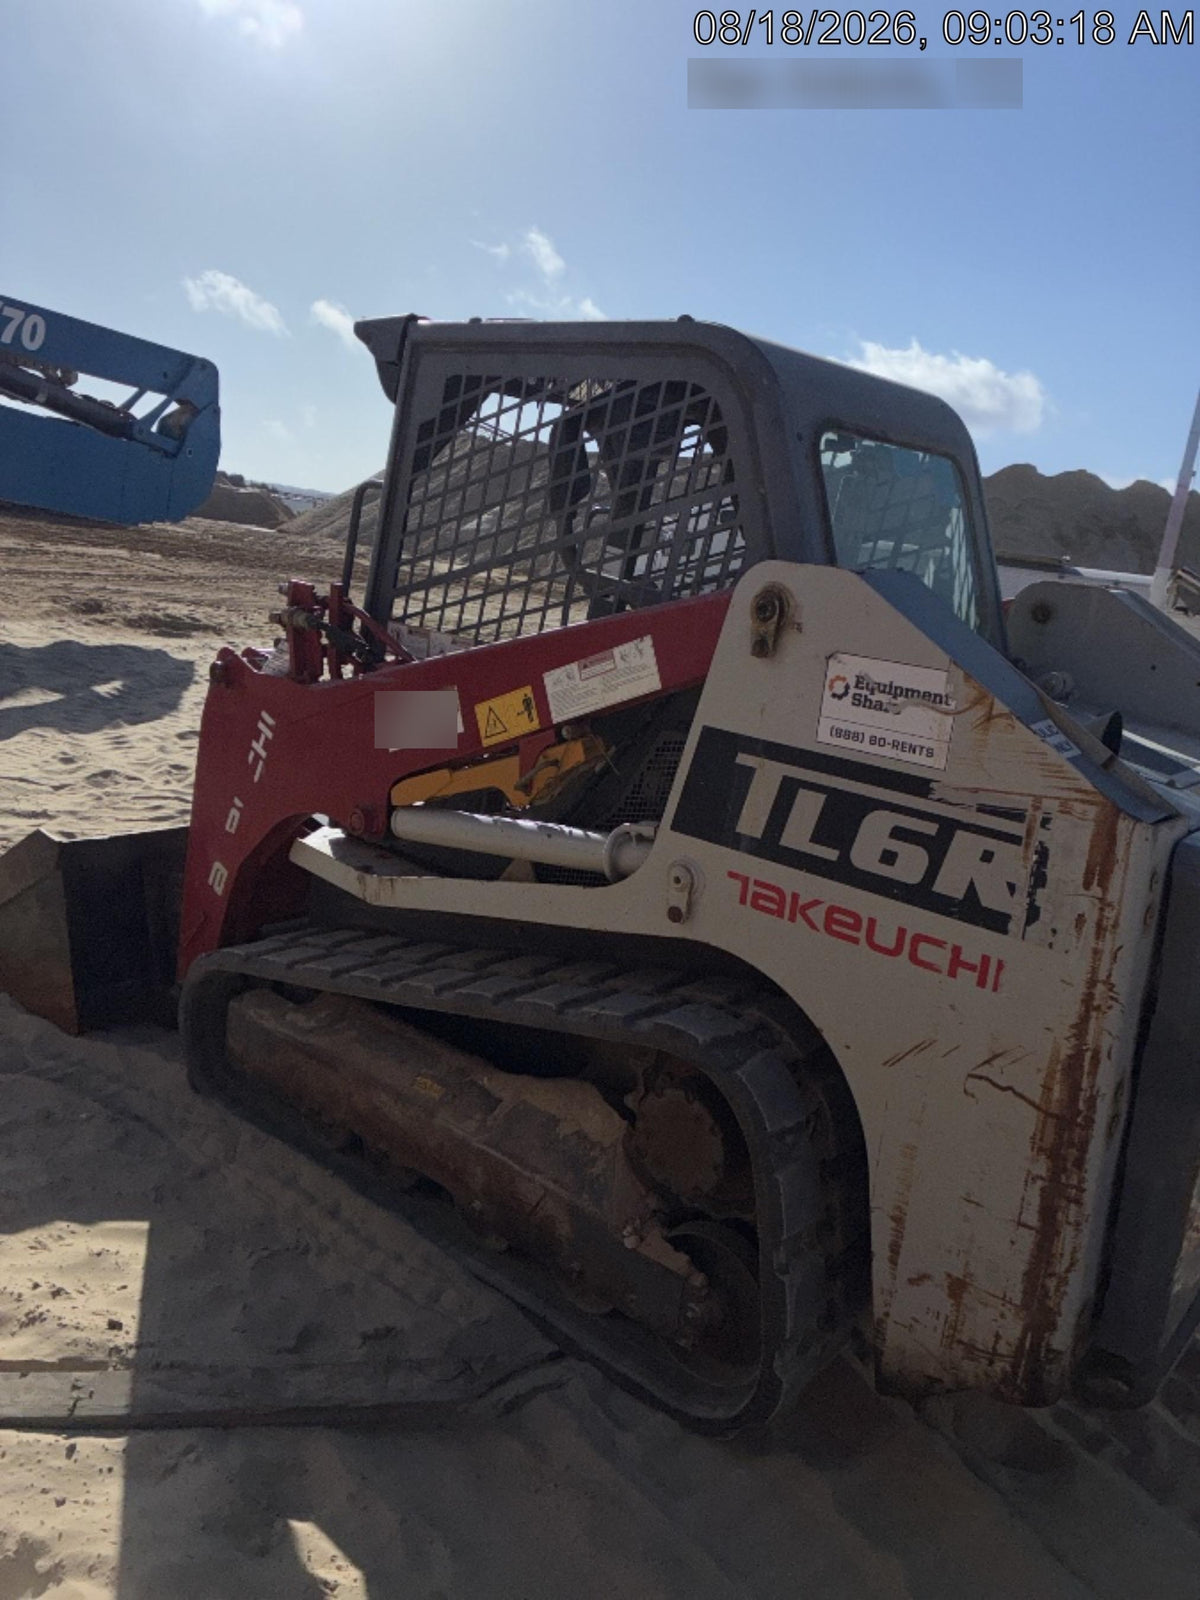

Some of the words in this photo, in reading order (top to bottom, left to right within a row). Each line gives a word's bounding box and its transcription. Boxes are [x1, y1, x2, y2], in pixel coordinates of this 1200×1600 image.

[0, 302, 46, 350] 70
[829, 724, 865, 744] (888)
[735, 751, 1023, 915] TL6R
